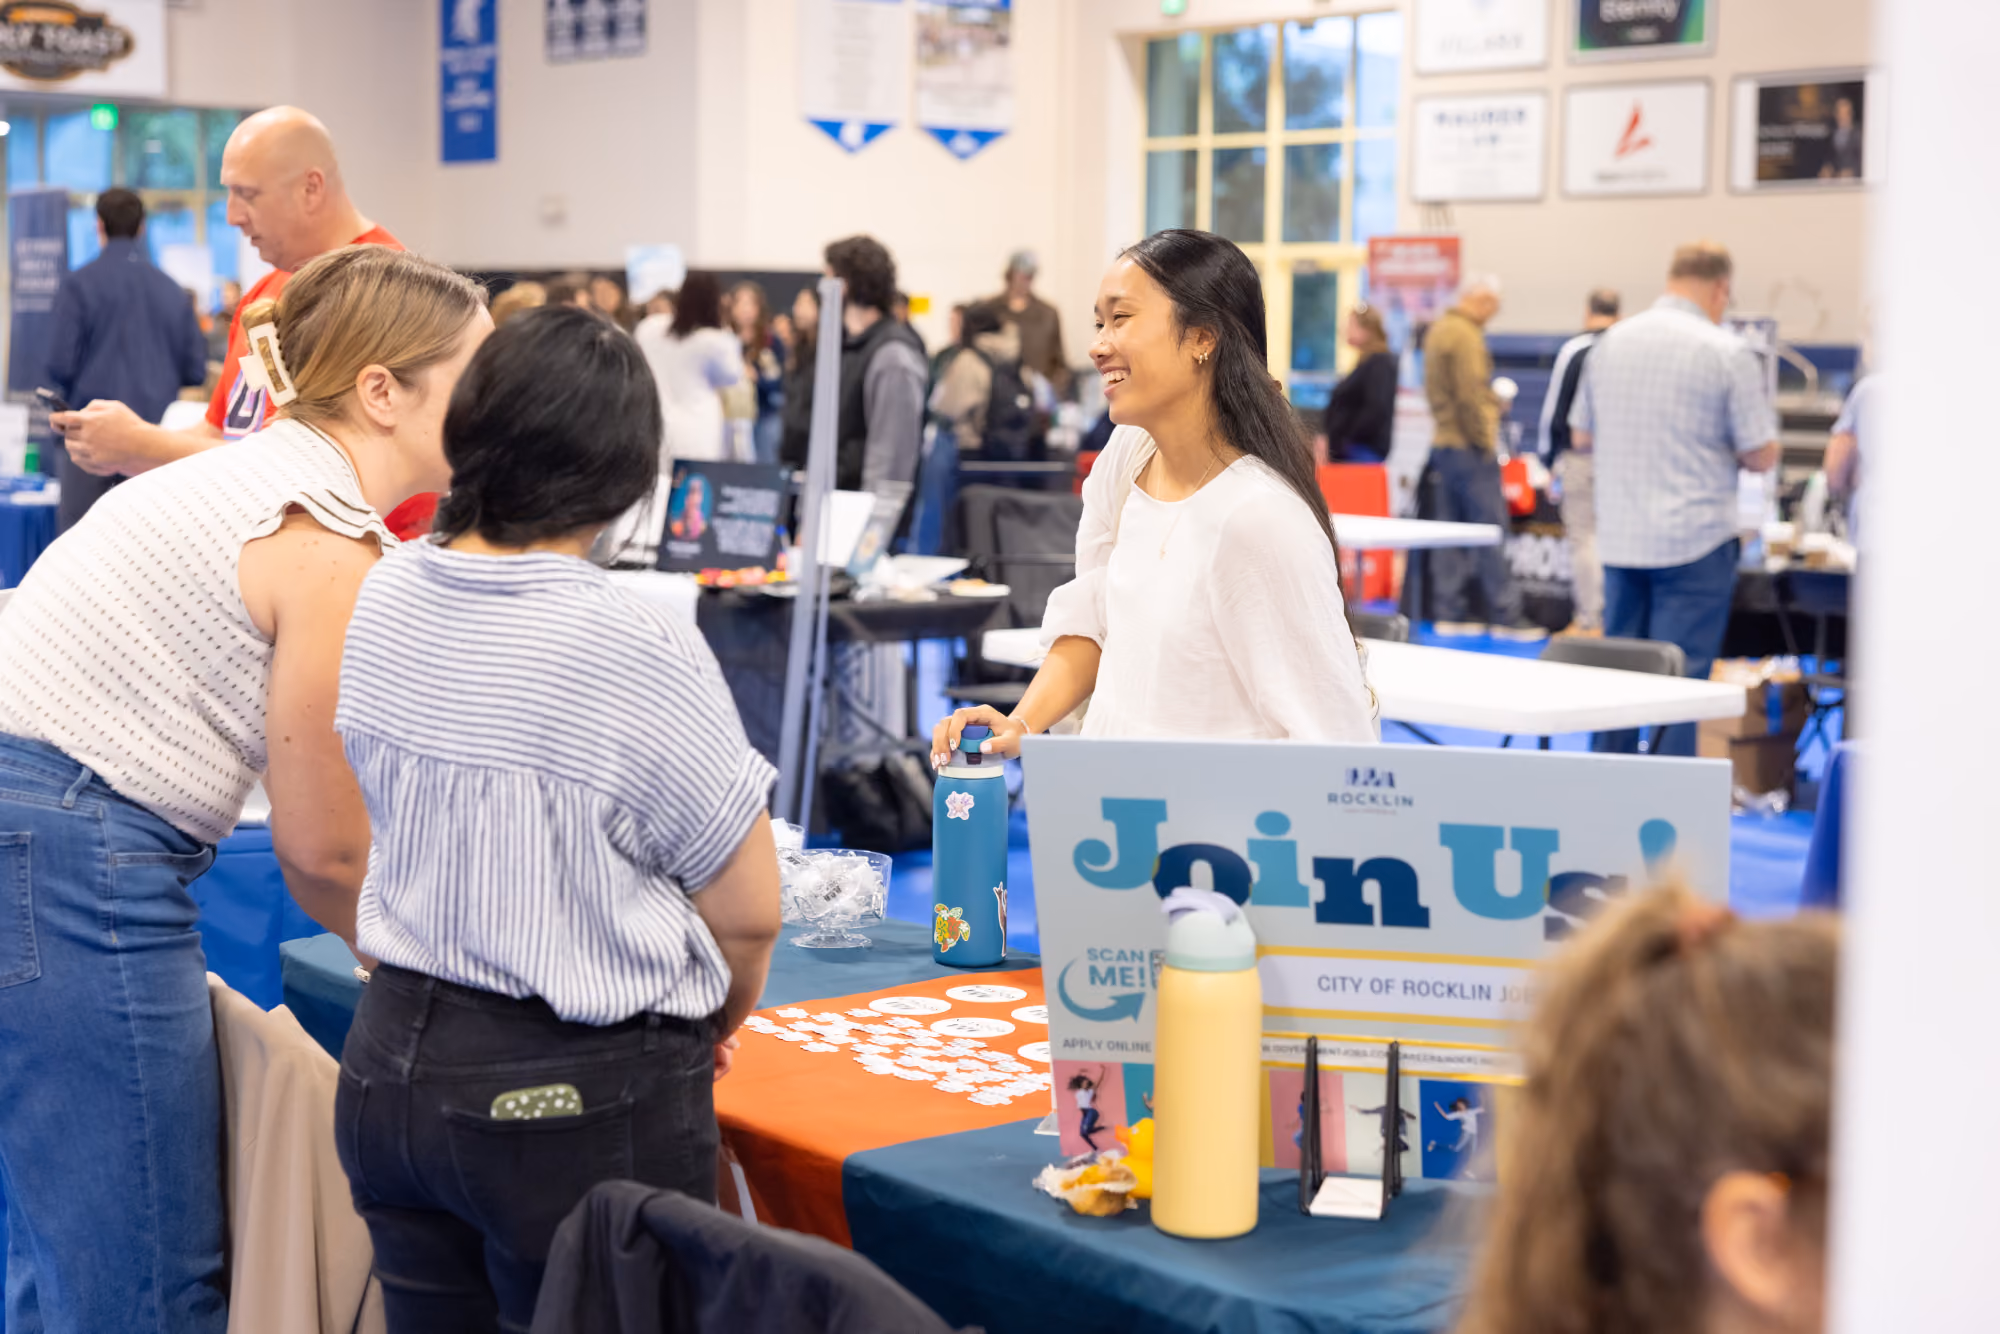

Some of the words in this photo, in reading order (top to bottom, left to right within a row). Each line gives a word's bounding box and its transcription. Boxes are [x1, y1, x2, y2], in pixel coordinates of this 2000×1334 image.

[1327, 792, 1414, 807] ROCKLIN
[1073, 797, 1430, 928] Join
[1087, 948, 1144, 962] SCAN
[1088, 964, 1145, 988] ME!
[1317, 975, 1362, 993] CITY
[1370, 977, 1395, 995] OF
[1403, 979, 1492, 1001] ROCKLIN
[1062, 1038, 1103, 1051] APPLY
[1107, 1040, 1153, 1053] ONLINE
